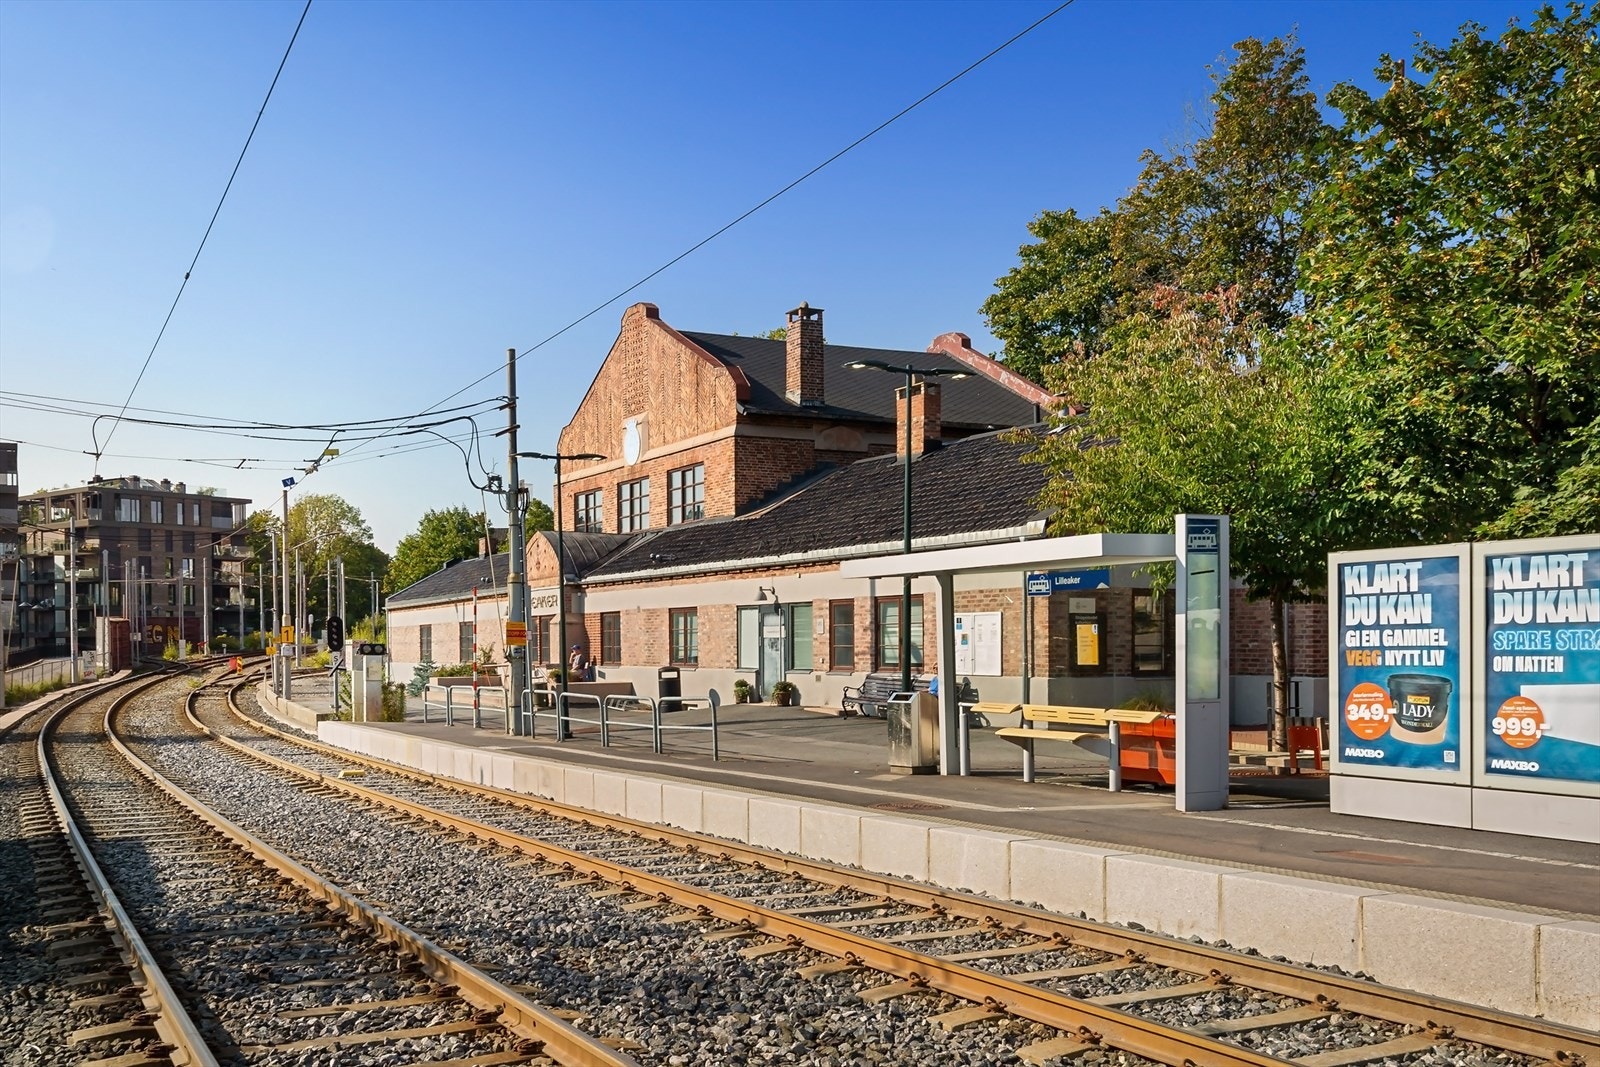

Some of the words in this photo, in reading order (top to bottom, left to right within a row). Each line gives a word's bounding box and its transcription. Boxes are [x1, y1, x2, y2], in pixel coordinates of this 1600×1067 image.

[1055, 576, 1081, 585] Lilleaker
[1344, 561, 1423, 596] KLART
[1492, 553, 1589, 591] KLART
[1345, 595, 1377, 626] DU
[1380, 593, 1432, 625] KAN
[1493, 591, 1533, 625] DU
[1536, 588, 1600, 624] KAN
[283, 629, 289, 642] 1
[1345, 629, 1360, 647] GI
[1362, 629, 1380, 647] EN
[1382, 628, 1449, 647] GAMMEL
[1493, 630, 1552, 650] SPARE
[1345, 649, 1382, 666] VEGG
[1384, 649, 1421, 666] NYTT
[1421, 649, 1445, 666] LIV
[1493, 655, 1514, 672] OM
[1515, 655, 1564, 673] NATTEN
[1402, 703, 1436, 718] LADY
[1345, 747, 1385, 759] MAXBO
[1491, 759, 1540, 772] MAXBO
